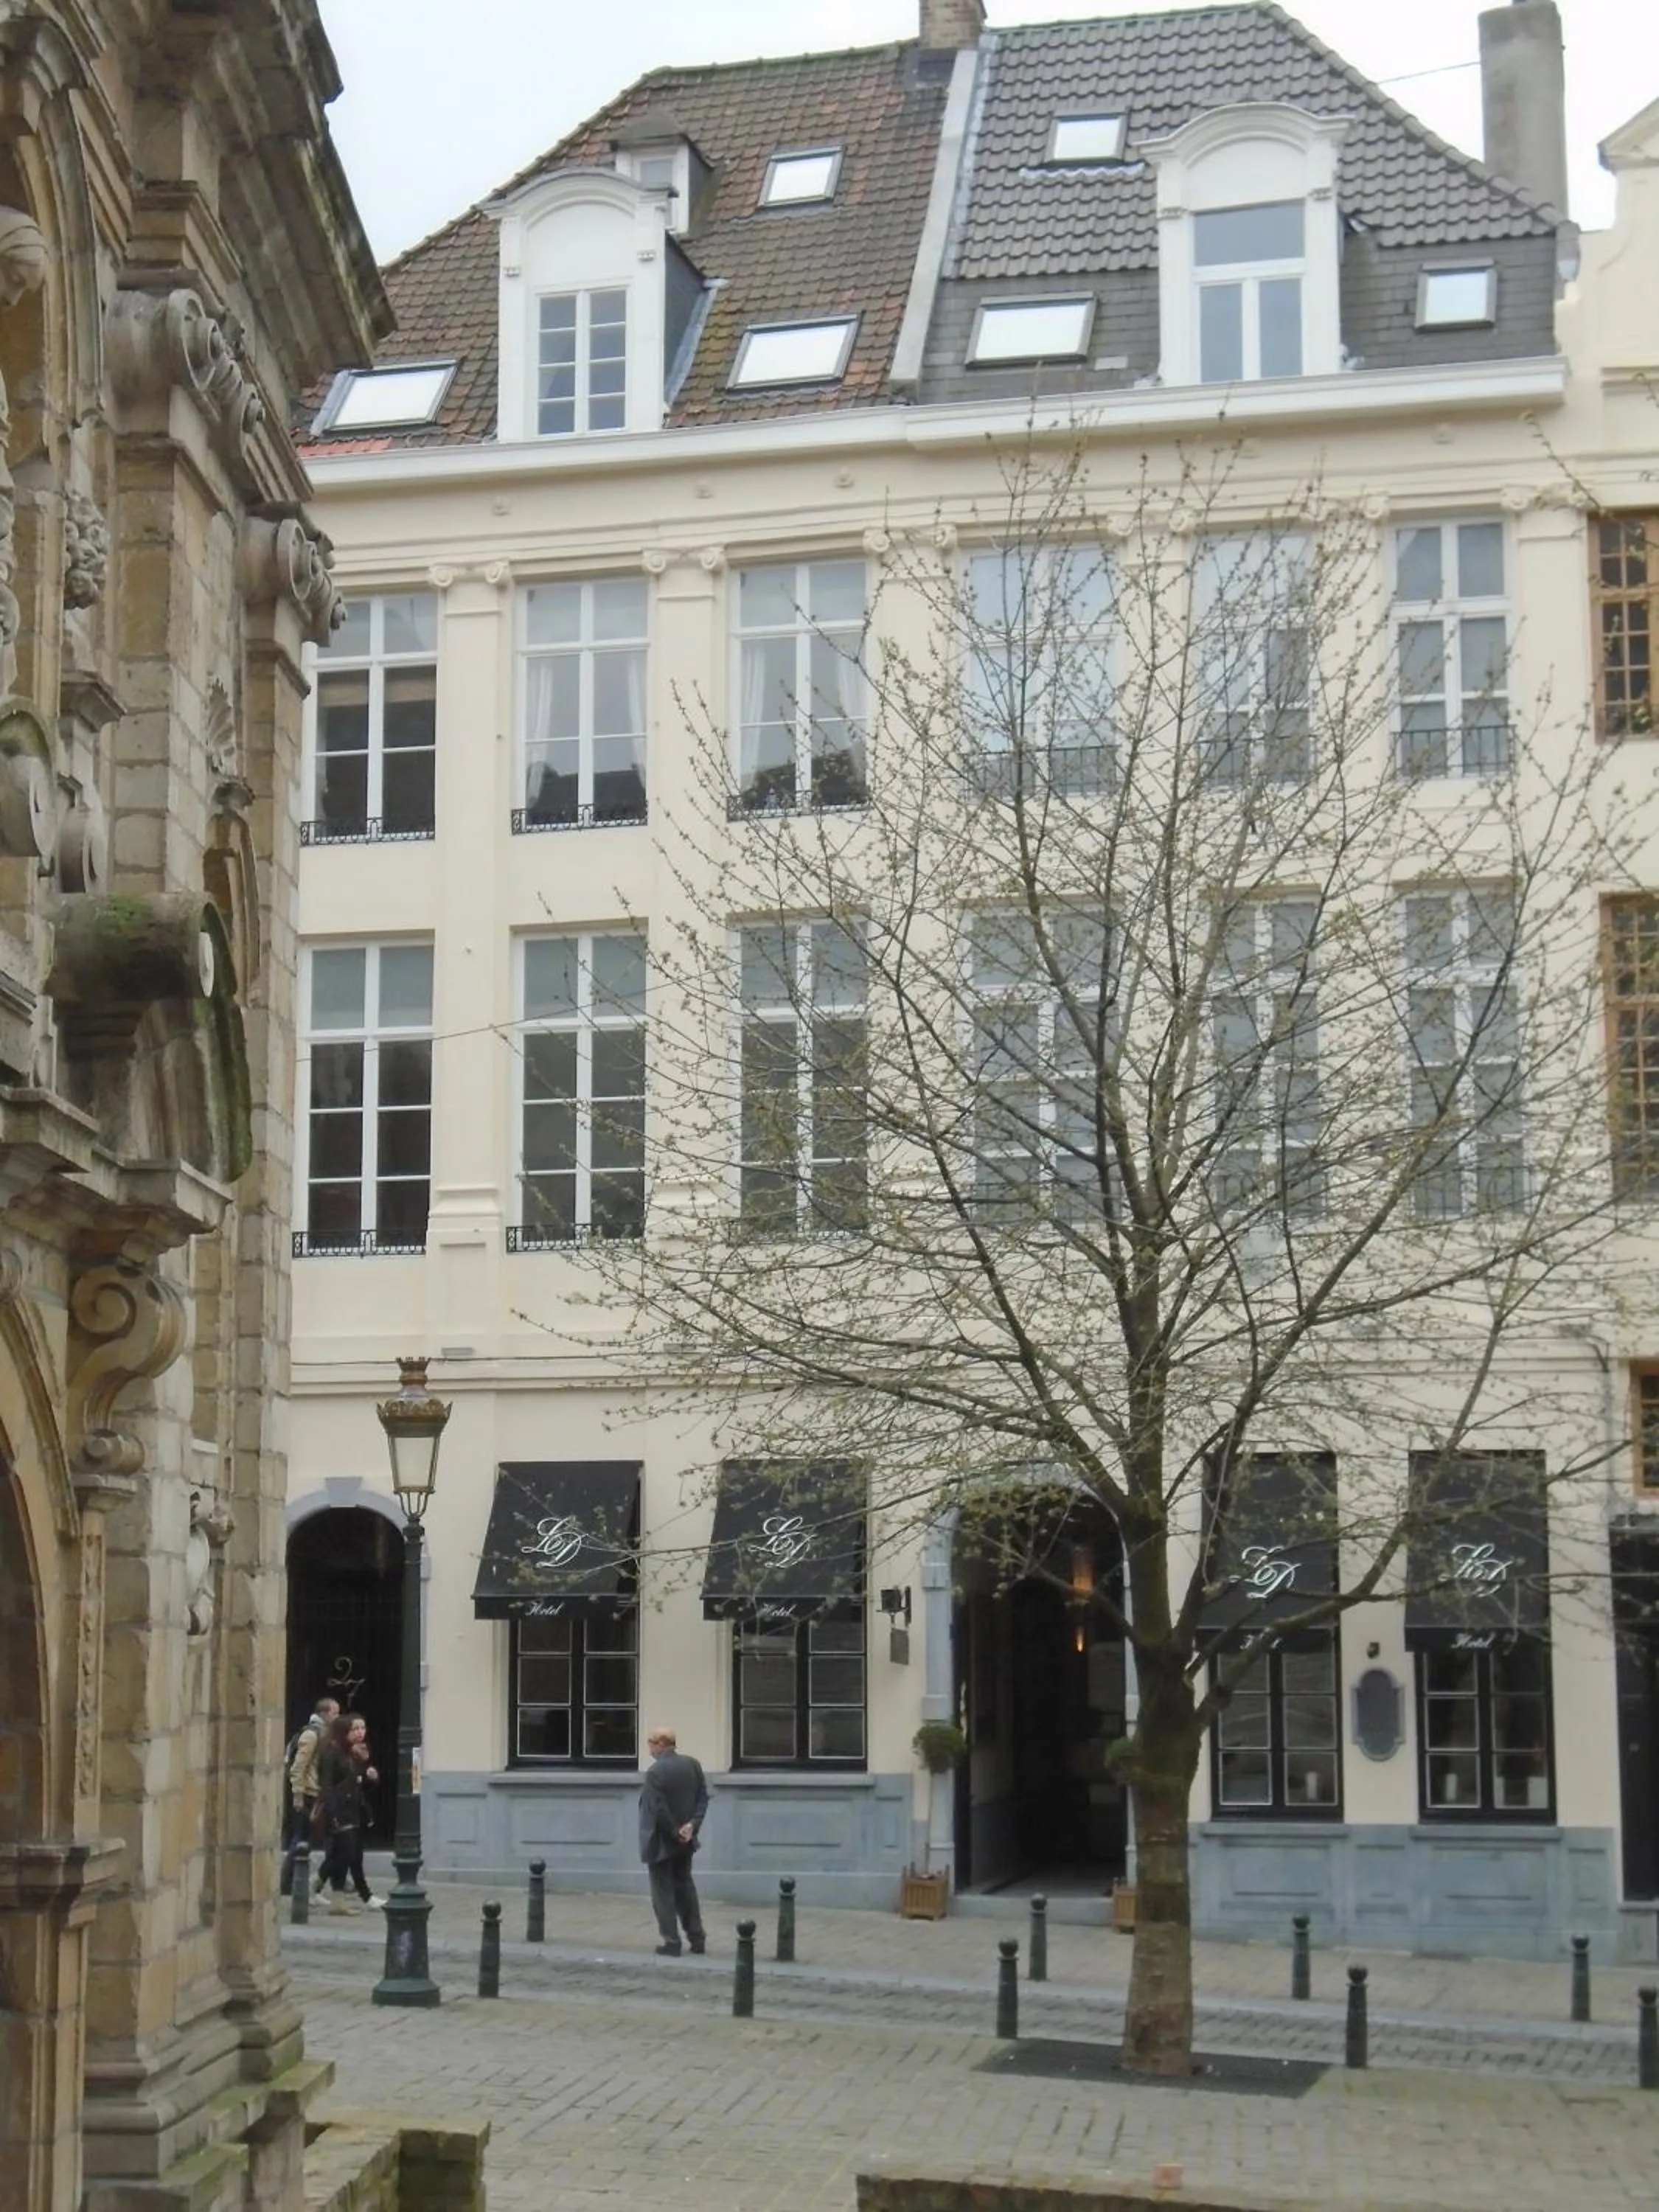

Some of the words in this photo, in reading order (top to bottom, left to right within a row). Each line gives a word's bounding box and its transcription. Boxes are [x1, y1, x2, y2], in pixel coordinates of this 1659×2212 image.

[525, 1602, 563, 1616] Hotel
[762, 1602, 796, 1617] Hotel
[1451, 1633, 1494, 1649] Hotel
[328, 1657, 365, 1708] 27
